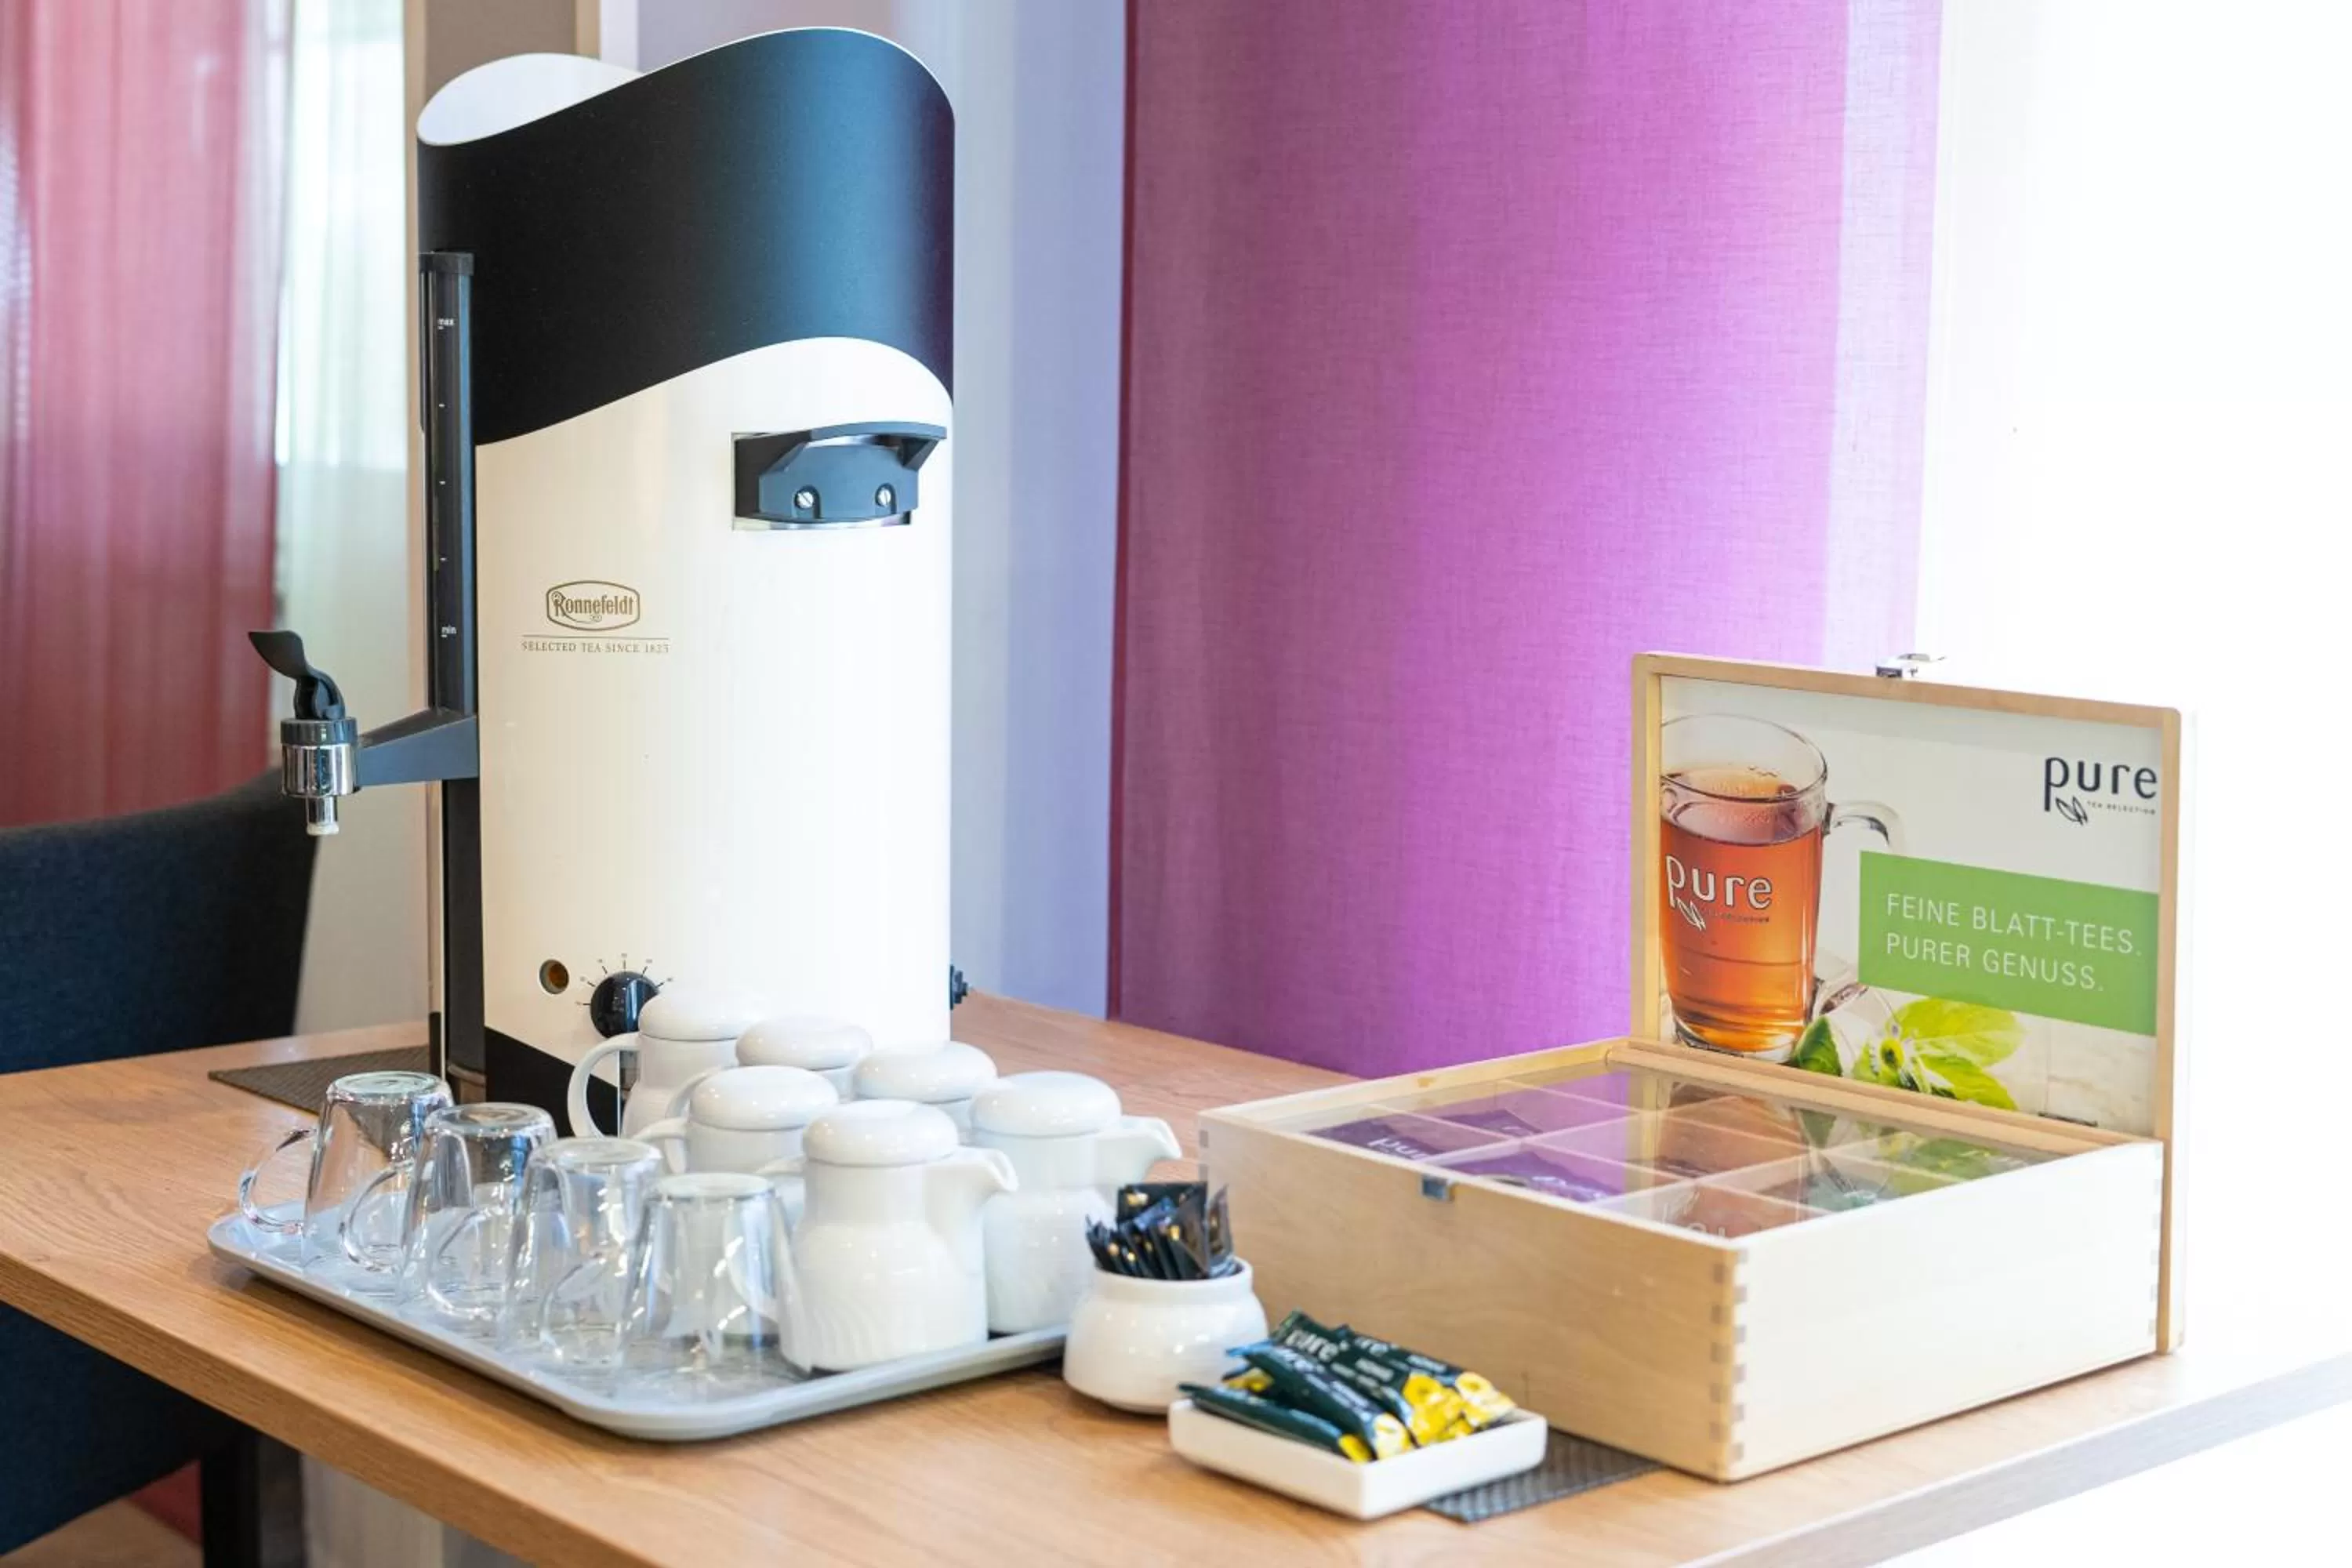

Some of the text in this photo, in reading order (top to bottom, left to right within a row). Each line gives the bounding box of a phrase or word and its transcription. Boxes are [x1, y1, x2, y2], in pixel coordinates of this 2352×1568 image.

[551, 591, 633, 622] Ronnefeldt
[521, 641, 576, 652] SELECTED
[582, 642, 603, 653] TEA
[606, 643, 640, 653] SINCE
[2044, 757, 2157, 812] pure
[1666, 855, 1772, 909] pure
[1887, 893, 2142, 956] FEINE BLATT-TEES.
[1887, 932, 2103, 992] PURER GENUSS.
